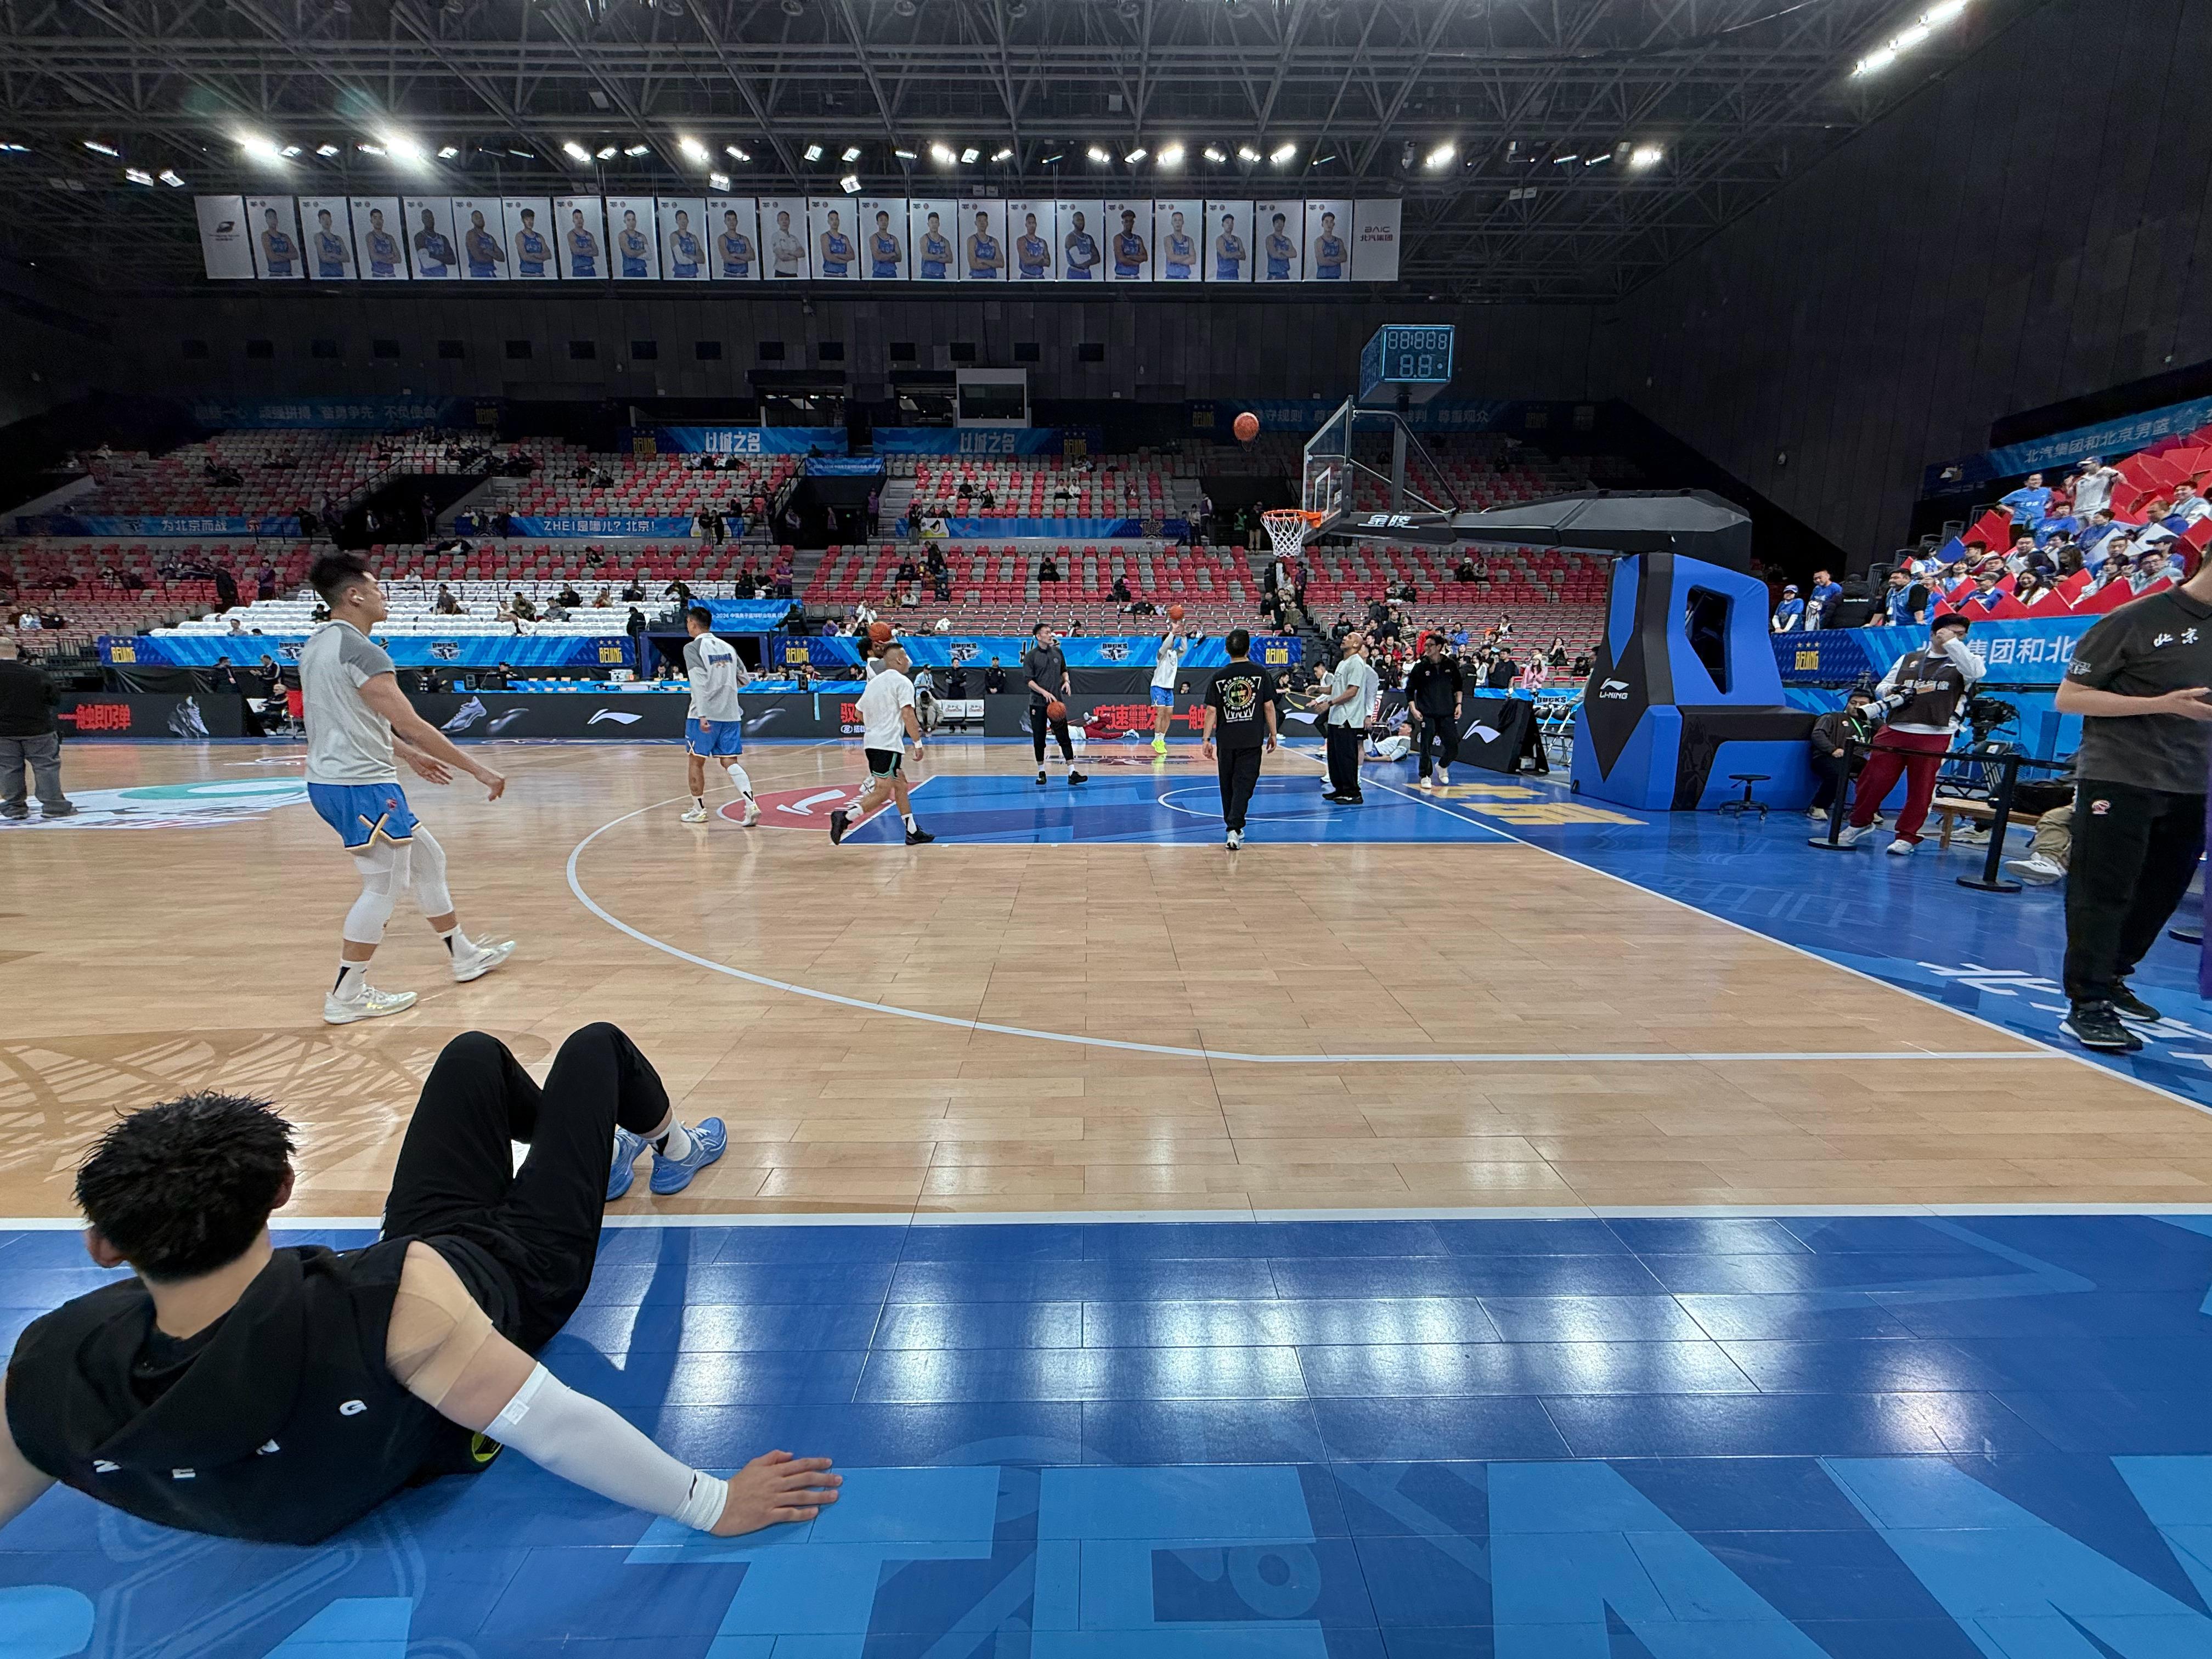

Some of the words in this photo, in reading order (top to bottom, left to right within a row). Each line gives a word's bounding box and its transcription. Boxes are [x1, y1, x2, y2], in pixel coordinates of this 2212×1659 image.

[383, 405, 436, 419] 不负使命
[633, 437, 657, 454] BEIJING
[706, 431, 760, 452] 以城之名
[960, 432, 1015, 453] 以城之名
[1064, 439, 1087, 455] BEIJING
[2024, 417, 2170, 464] 北汽集团和北京男篮
[161, 520, 227, 532] 为北京而战
[2153, 627, 2199, 648] 北京
[111, 646, 136, 663] BEIJING
[599, 647, 623, 664] BEIJING
[786, 647, 809, 664] BEIJING
[1266, 648, 1288, 664] BEIJING
[1795, 650, 1818, 670] BEIJING
[1599, 691, 1628, 700] LI-NING
